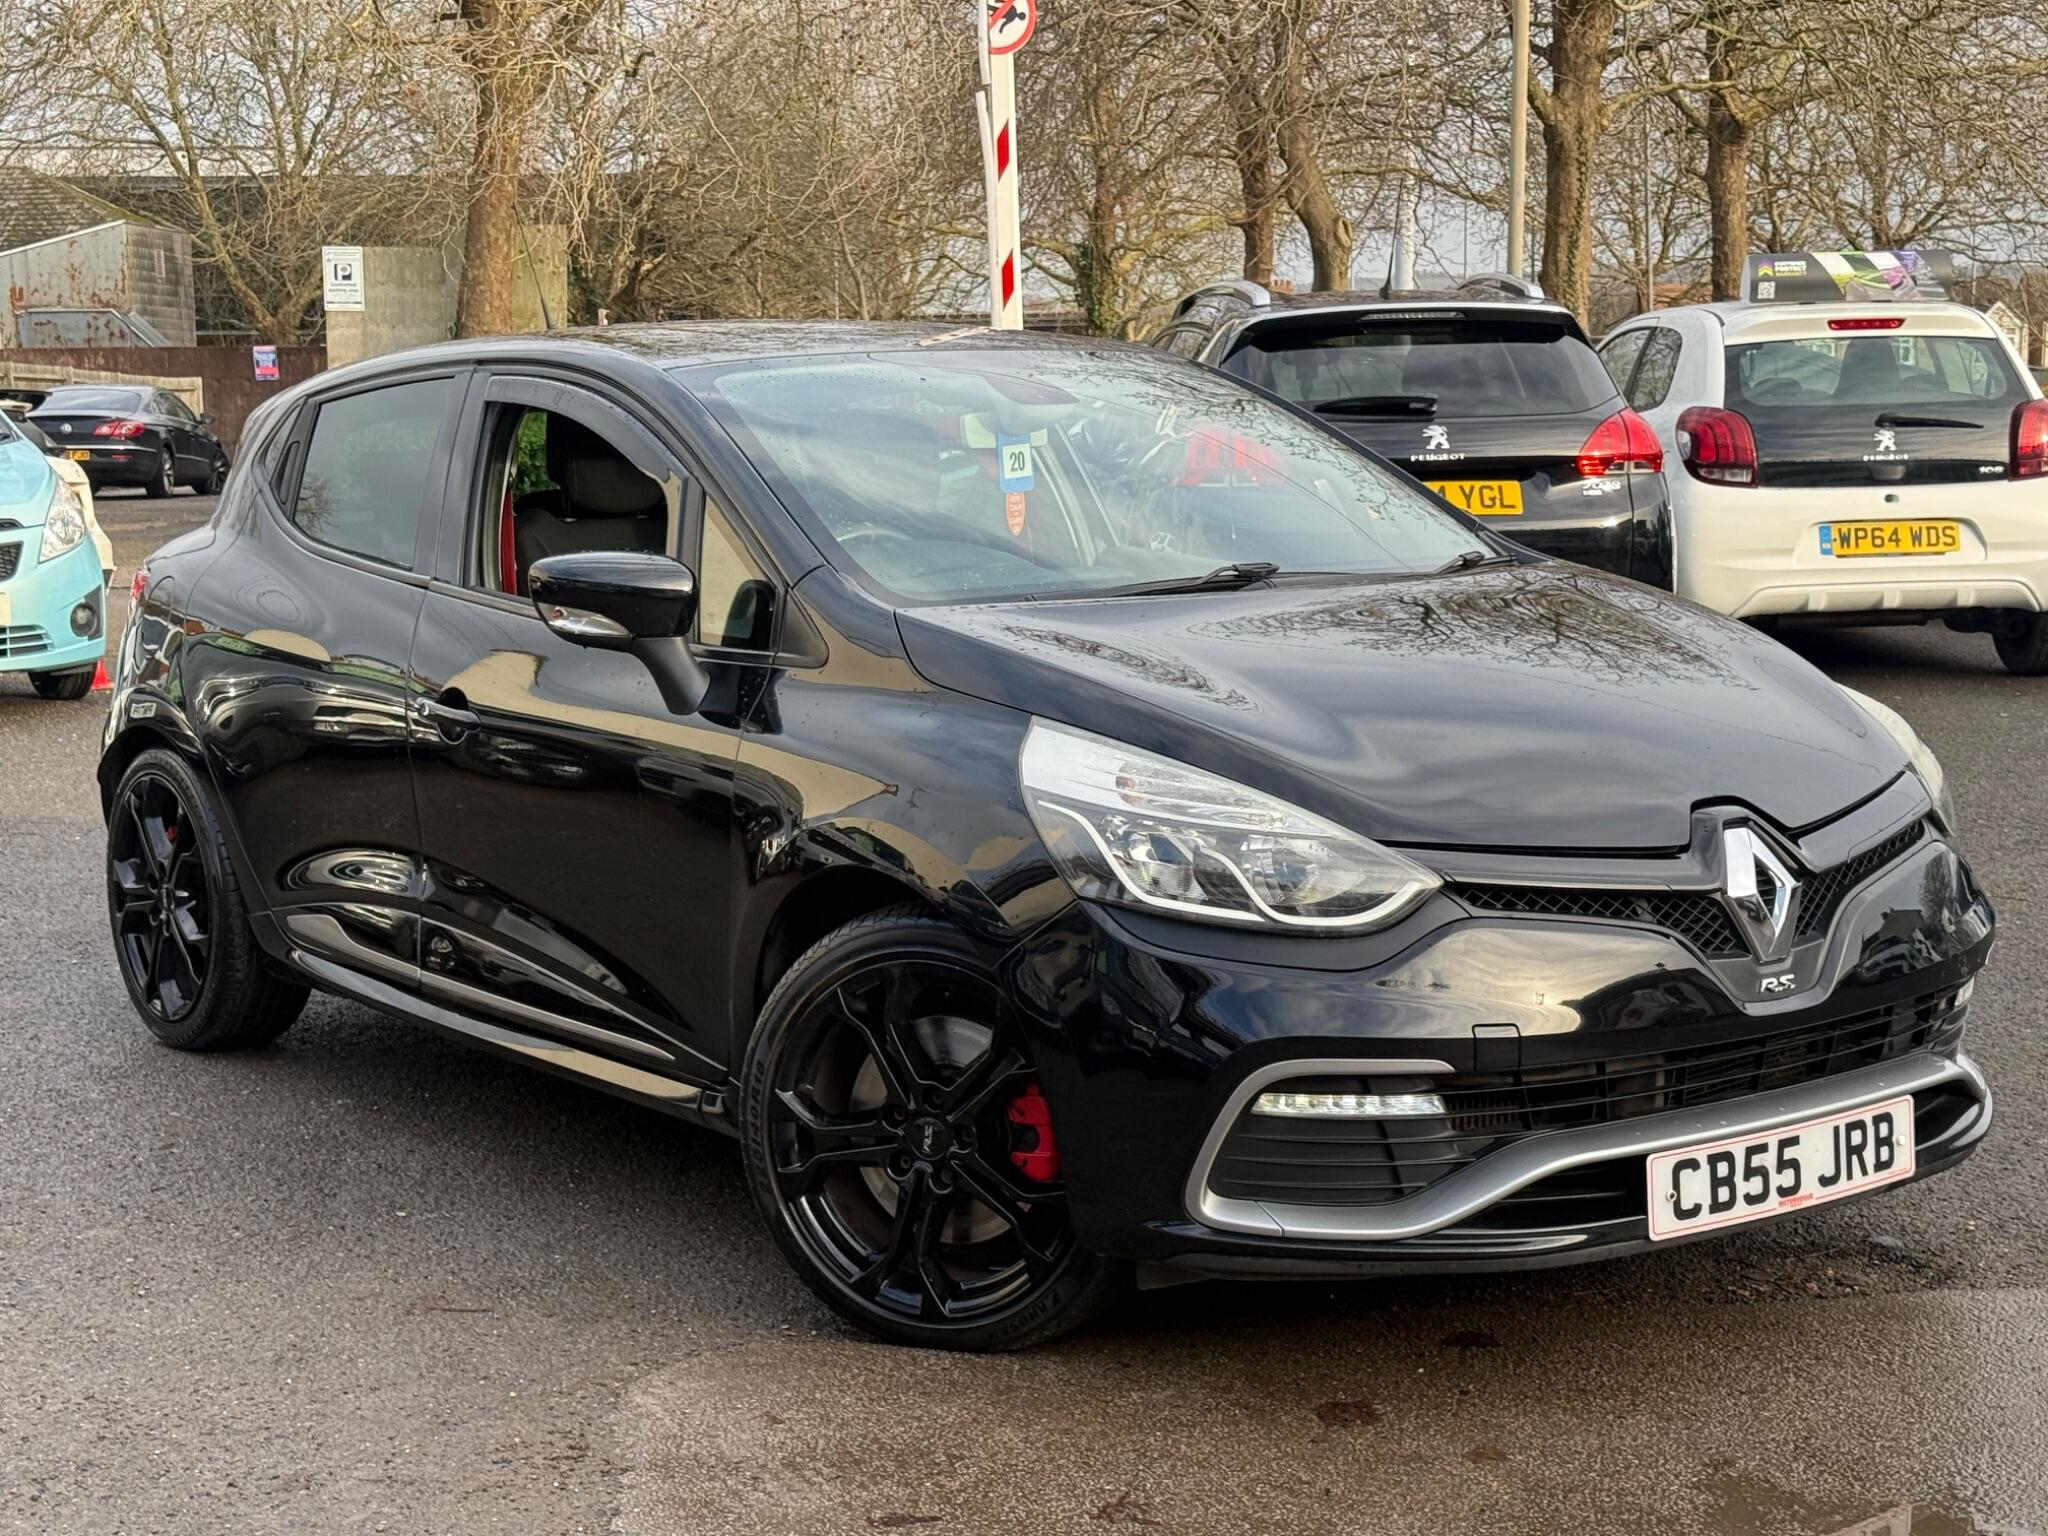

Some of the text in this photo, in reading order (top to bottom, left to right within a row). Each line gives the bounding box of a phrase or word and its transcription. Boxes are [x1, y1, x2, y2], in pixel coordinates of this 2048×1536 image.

[1010, 451, 1025, 472] 20
[1410, 453, 1465, 462] PEUGEOT
[1458, 484, 1516, 509] YGL
[1838, 525, 1956, 549] WP64 WDS
[1760, 974, 1796, 992] RS
[1671, 1111, 1896, 1221] CB55 JRB
